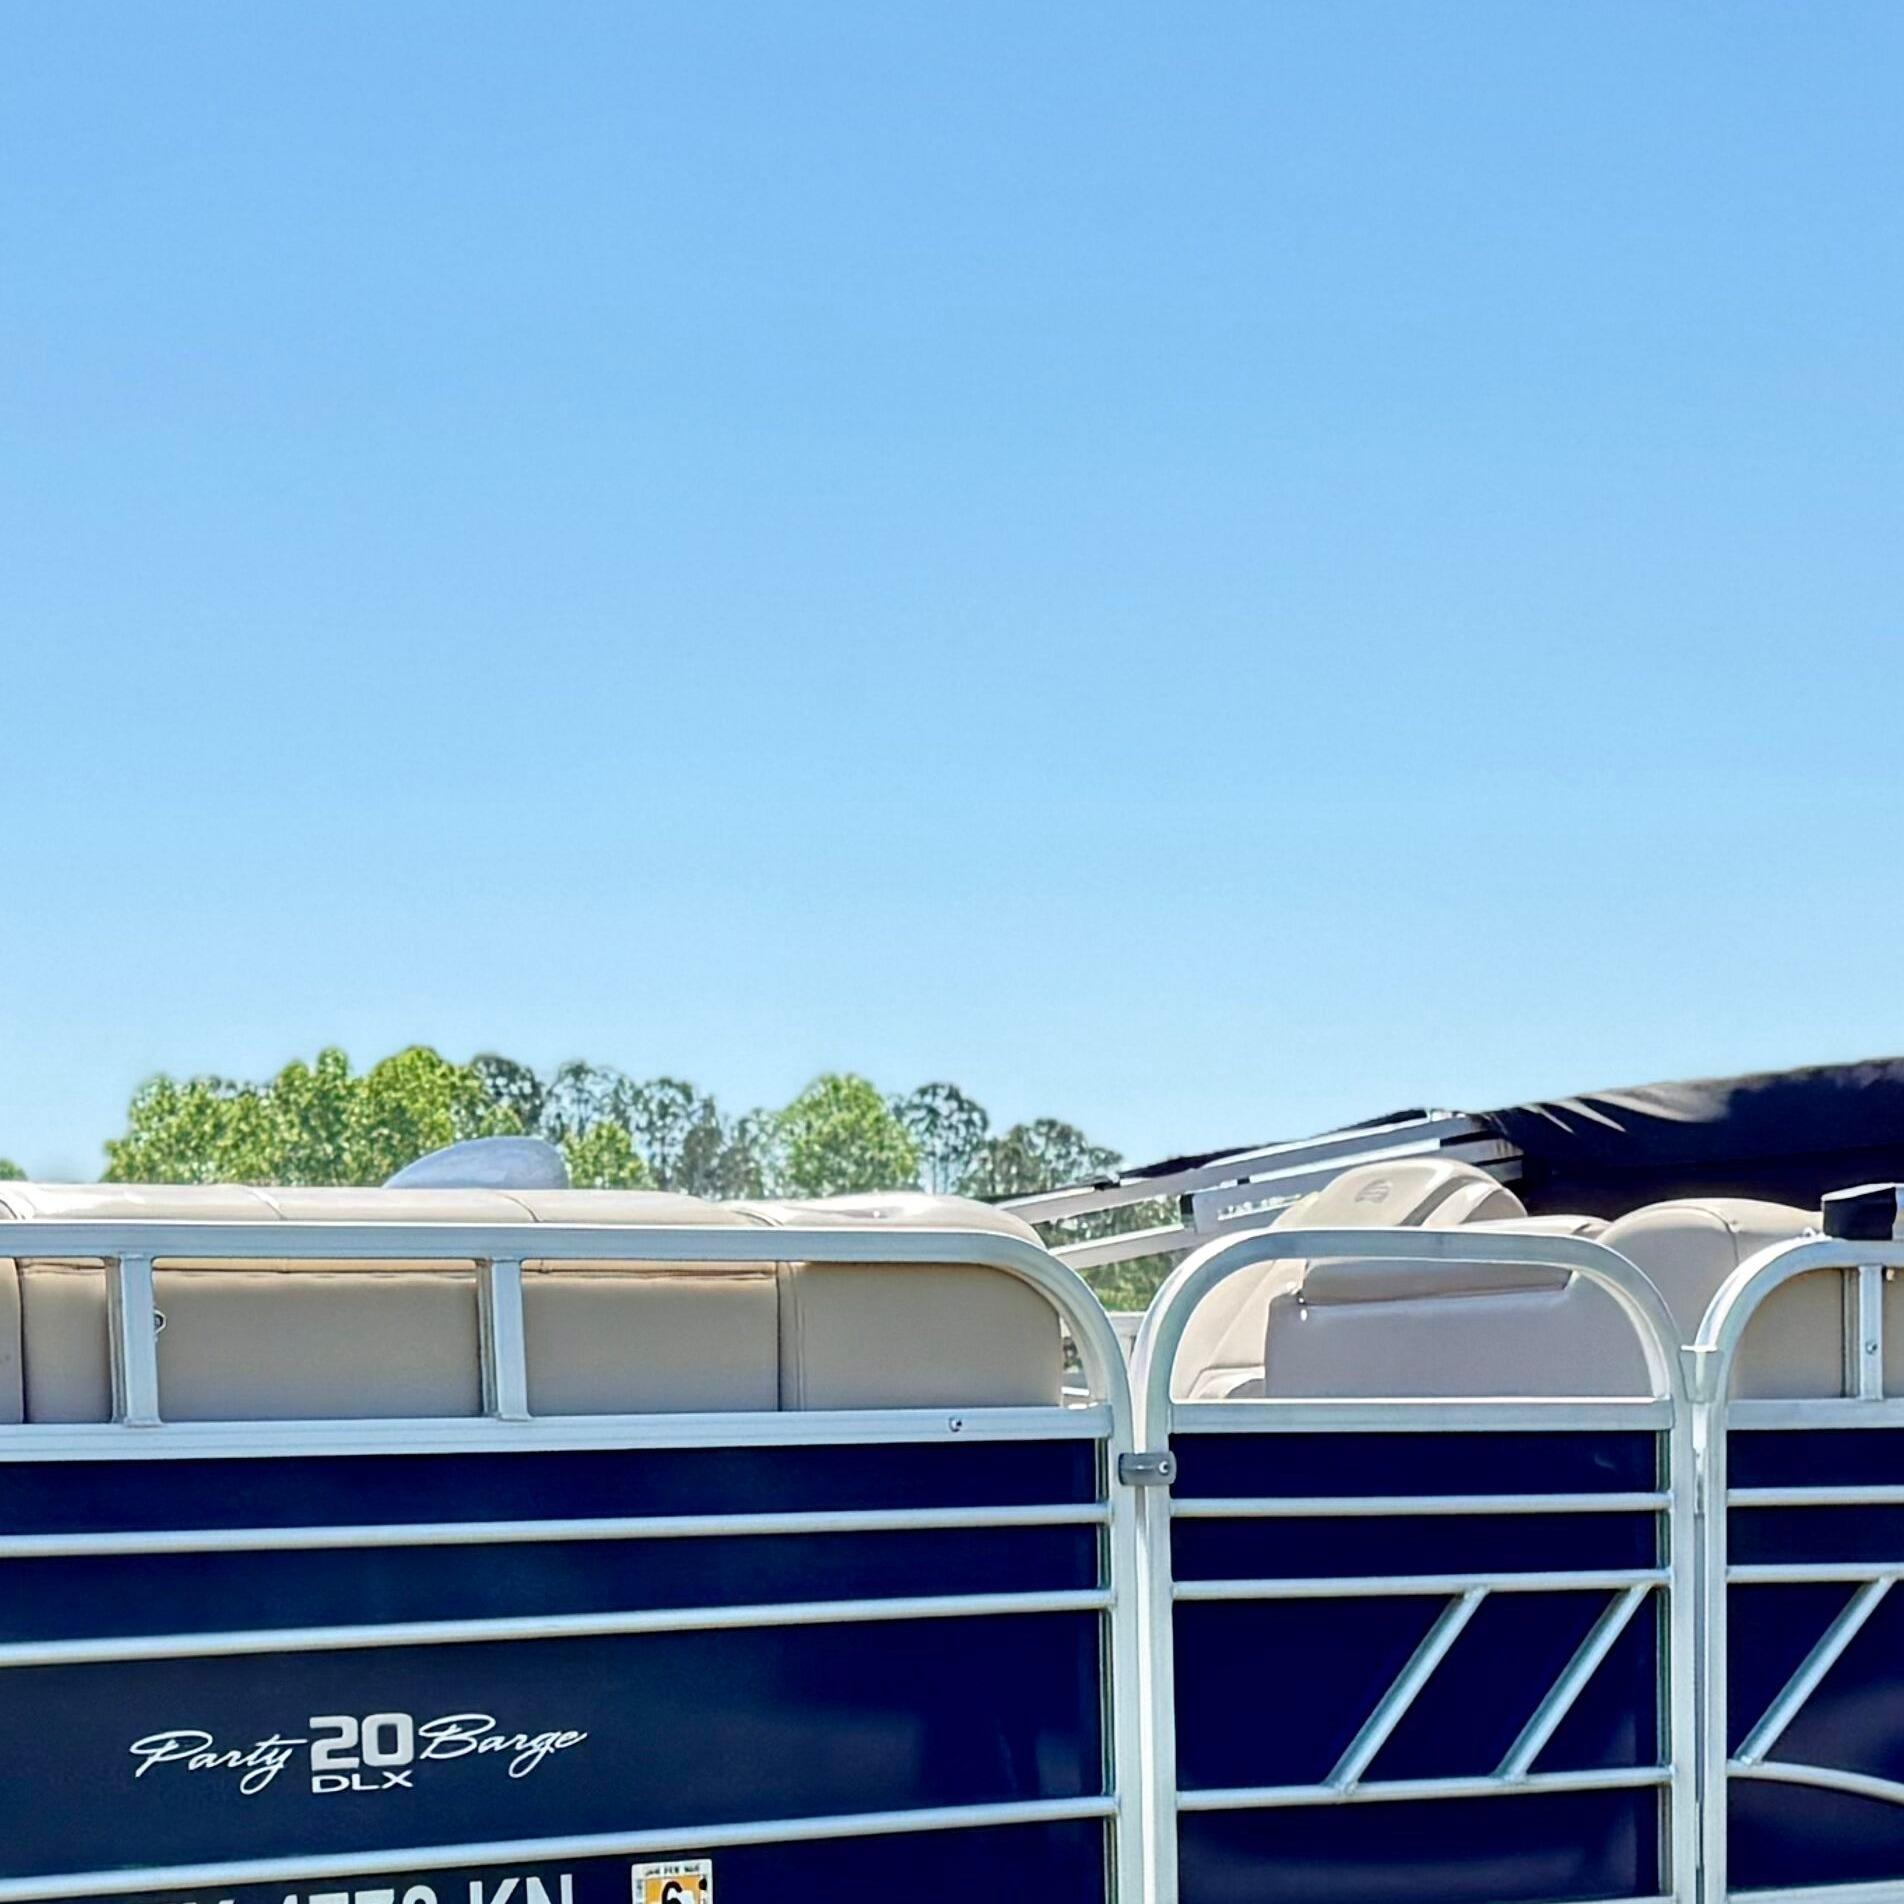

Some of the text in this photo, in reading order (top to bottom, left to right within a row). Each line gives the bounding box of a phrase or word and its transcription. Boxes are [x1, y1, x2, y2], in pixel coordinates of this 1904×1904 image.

[130, 1713, 587, 1794] Party 20 Barge
[312, 1771, 414, 1793] DLX
